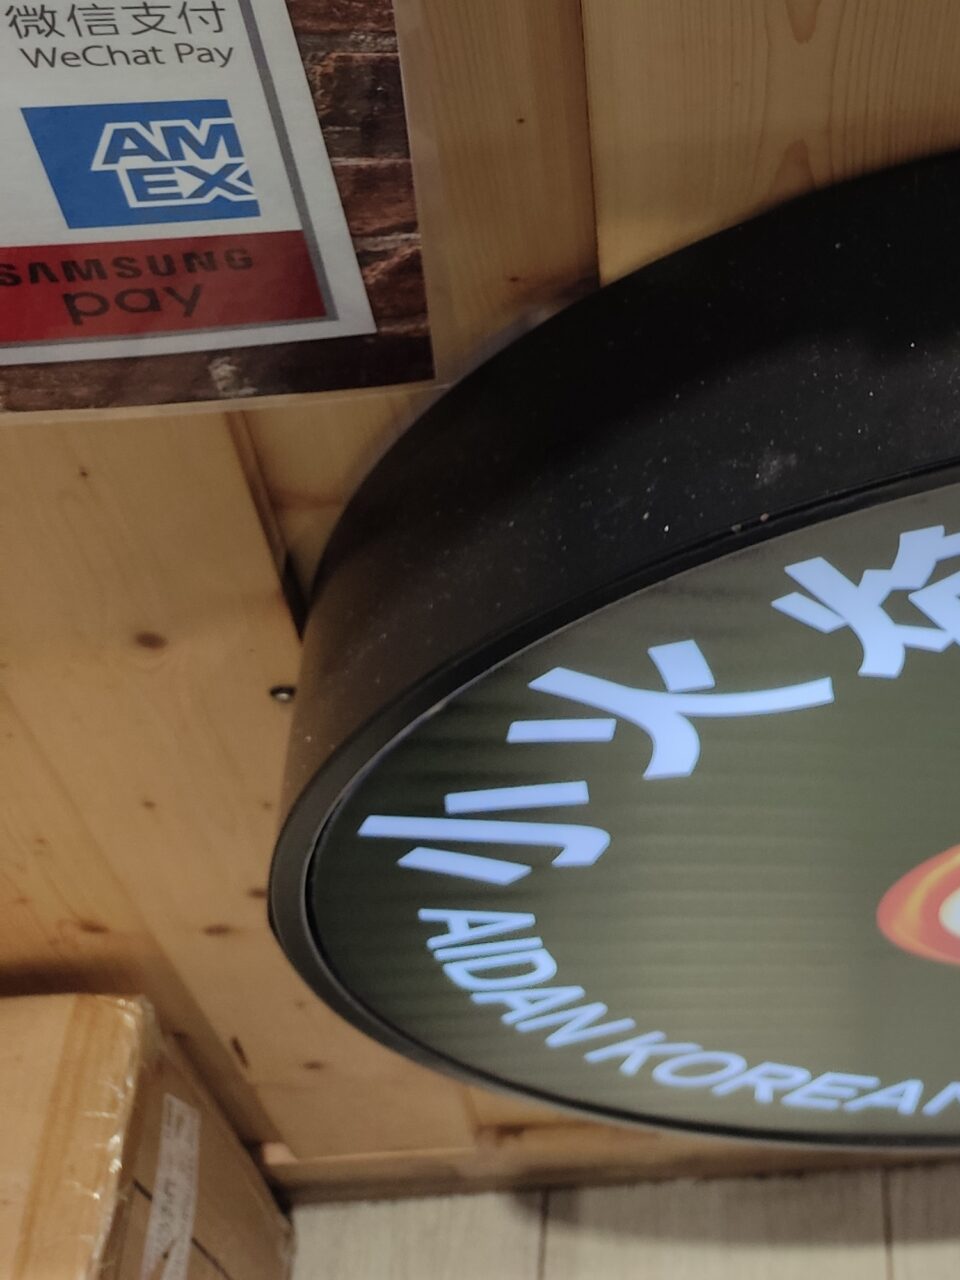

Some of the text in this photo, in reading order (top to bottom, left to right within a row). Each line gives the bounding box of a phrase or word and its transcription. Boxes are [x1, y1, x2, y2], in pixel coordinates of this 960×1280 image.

[5, 0, 226, 40] 微信支付
[20, 42, 234, 69] WeChat Pay
[97, 120, 245, 168] AM
[127, 164, 257, 207] EX
[0, 247, 254, 287] SAMSUNG
[62, 283, 204, 326] pay
[417, 906, 636, 1065] AIDAN
